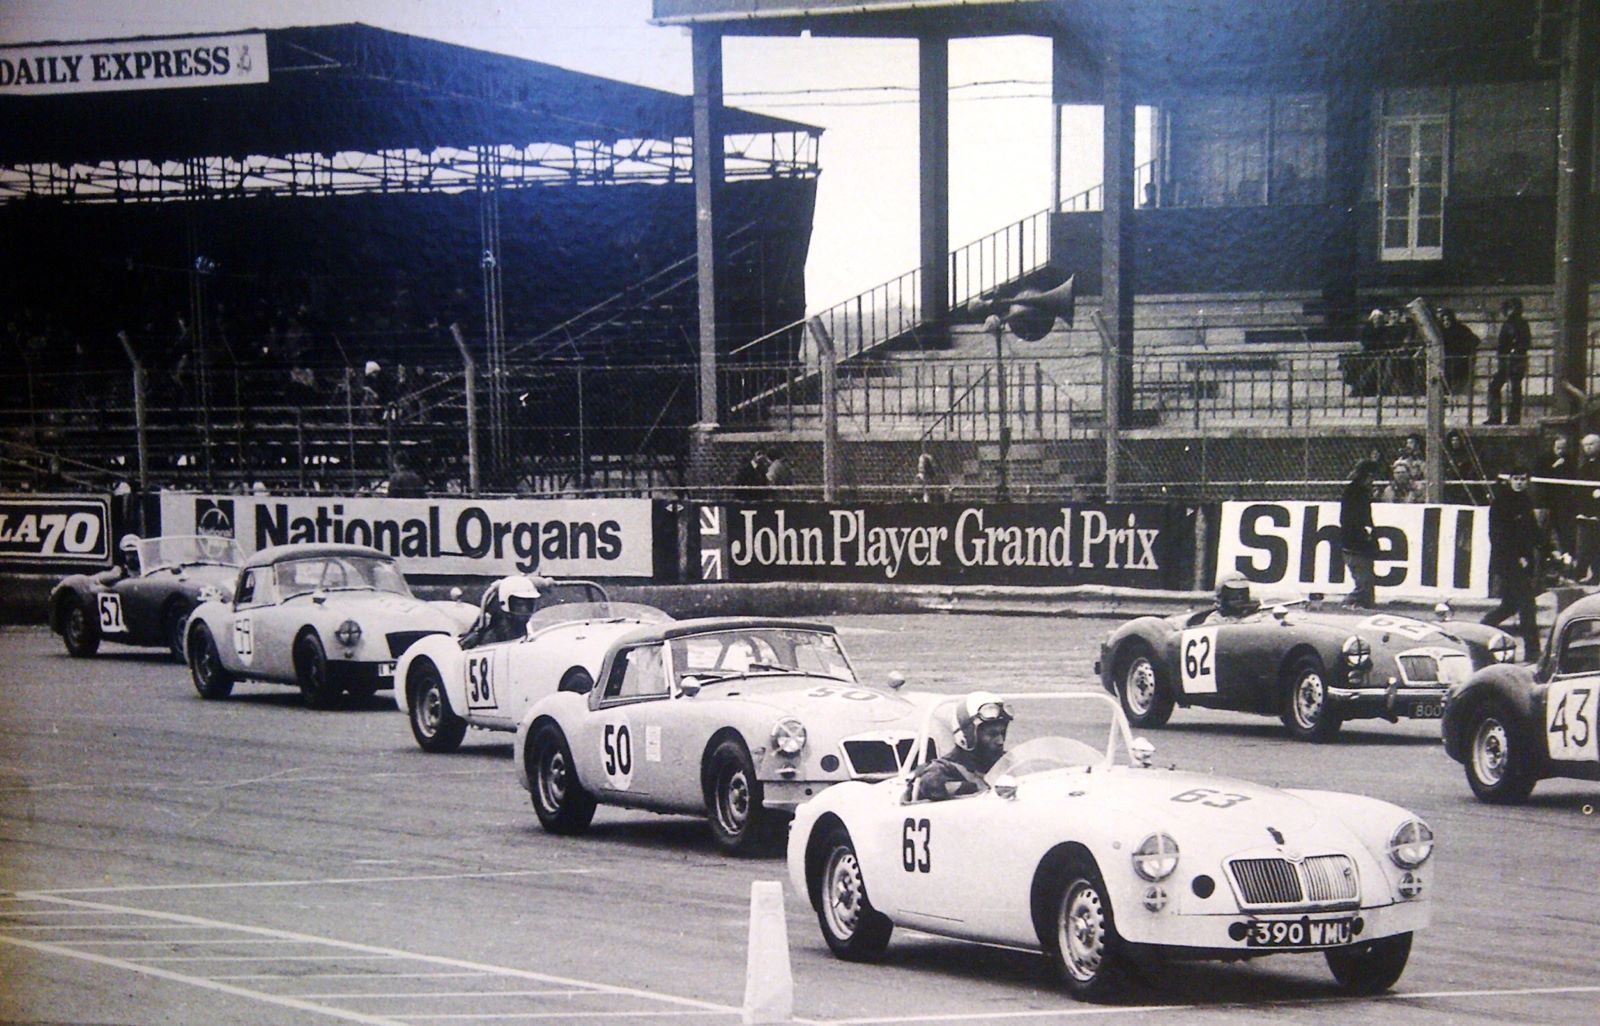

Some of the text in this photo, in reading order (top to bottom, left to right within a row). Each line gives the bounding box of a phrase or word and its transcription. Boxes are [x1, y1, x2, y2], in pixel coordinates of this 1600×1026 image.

[0, 46, 231, 86] DAILY EXPRESS
[255, 504, 622, 574] National Organs
[731, 508, 1160, 579] John Player Grand Prix
[1235, 504, 1475, 590] Shell
[100, 596, 120, 627] 57
[469, 657, 489, 702] 58
[1185, 635, 1210, 679] 62
[1550, 689, 1591, 748] 43
[604, 724, 631, 776] 50
[1170, 788, 1252, 808] 63
[903, 818, 931, 873] 63
[1255, 922, 1304, 944] 390
